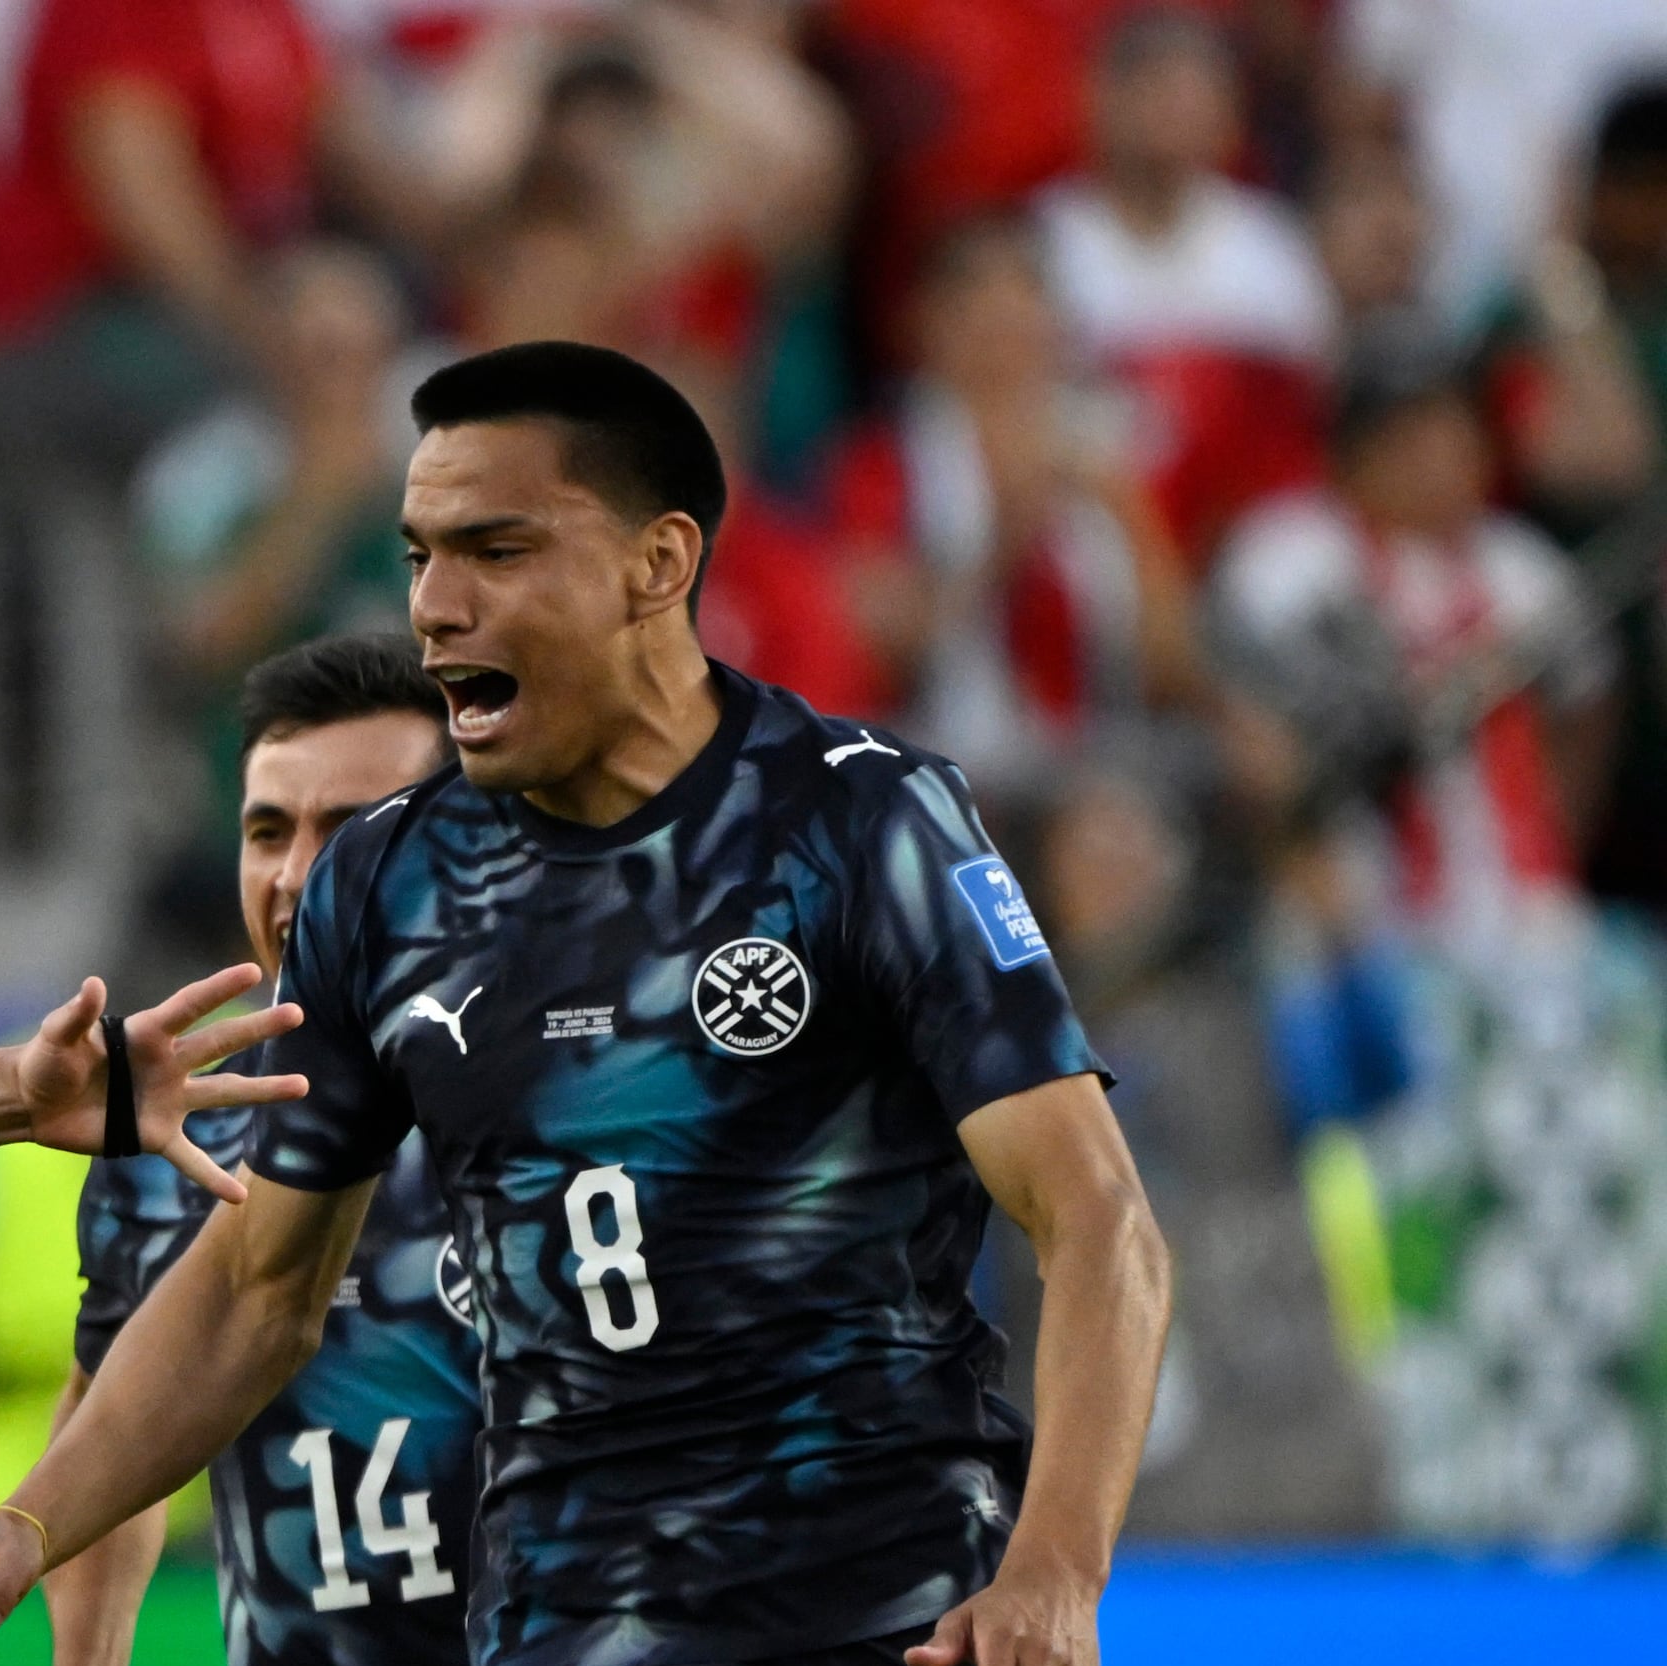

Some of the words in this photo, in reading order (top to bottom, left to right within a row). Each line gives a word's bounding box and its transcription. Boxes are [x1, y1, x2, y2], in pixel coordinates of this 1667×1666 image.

[732, 947, 771, 967] APF
[726, 1032, 779, 1048] PARAGUAY
[564, 1163, 659, 1352] 8
[289, 1418, 455, 1612] 14
